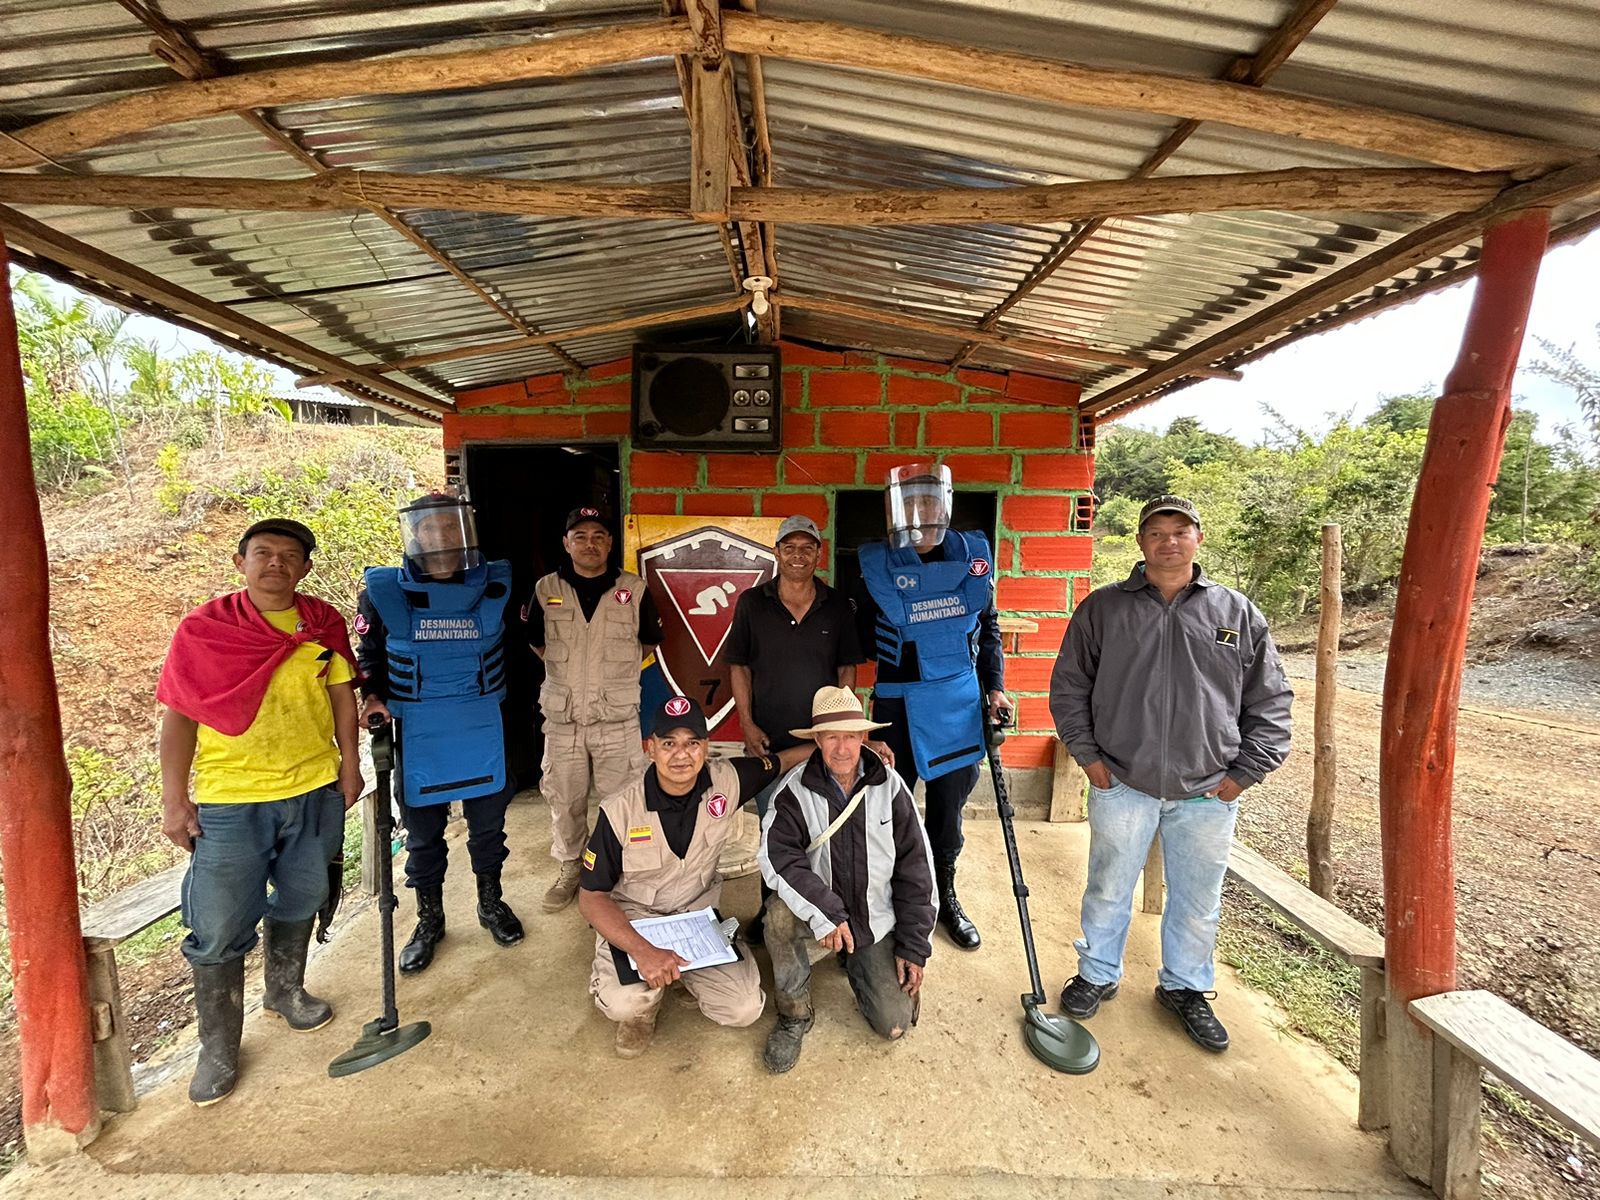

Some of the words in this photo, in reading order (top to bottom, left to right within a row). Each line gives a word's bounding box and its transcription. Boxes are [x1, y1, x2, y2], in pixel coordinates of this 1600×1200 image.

[911, 596, 960, 612] DESMINADO
[909, 605, 966, 623] HUMANITARIO
[420, 619, 475, 629] DESMINADO
[415, 629, 479, 640] HUMANITARIO
[700, 678, 721, 706] 7
